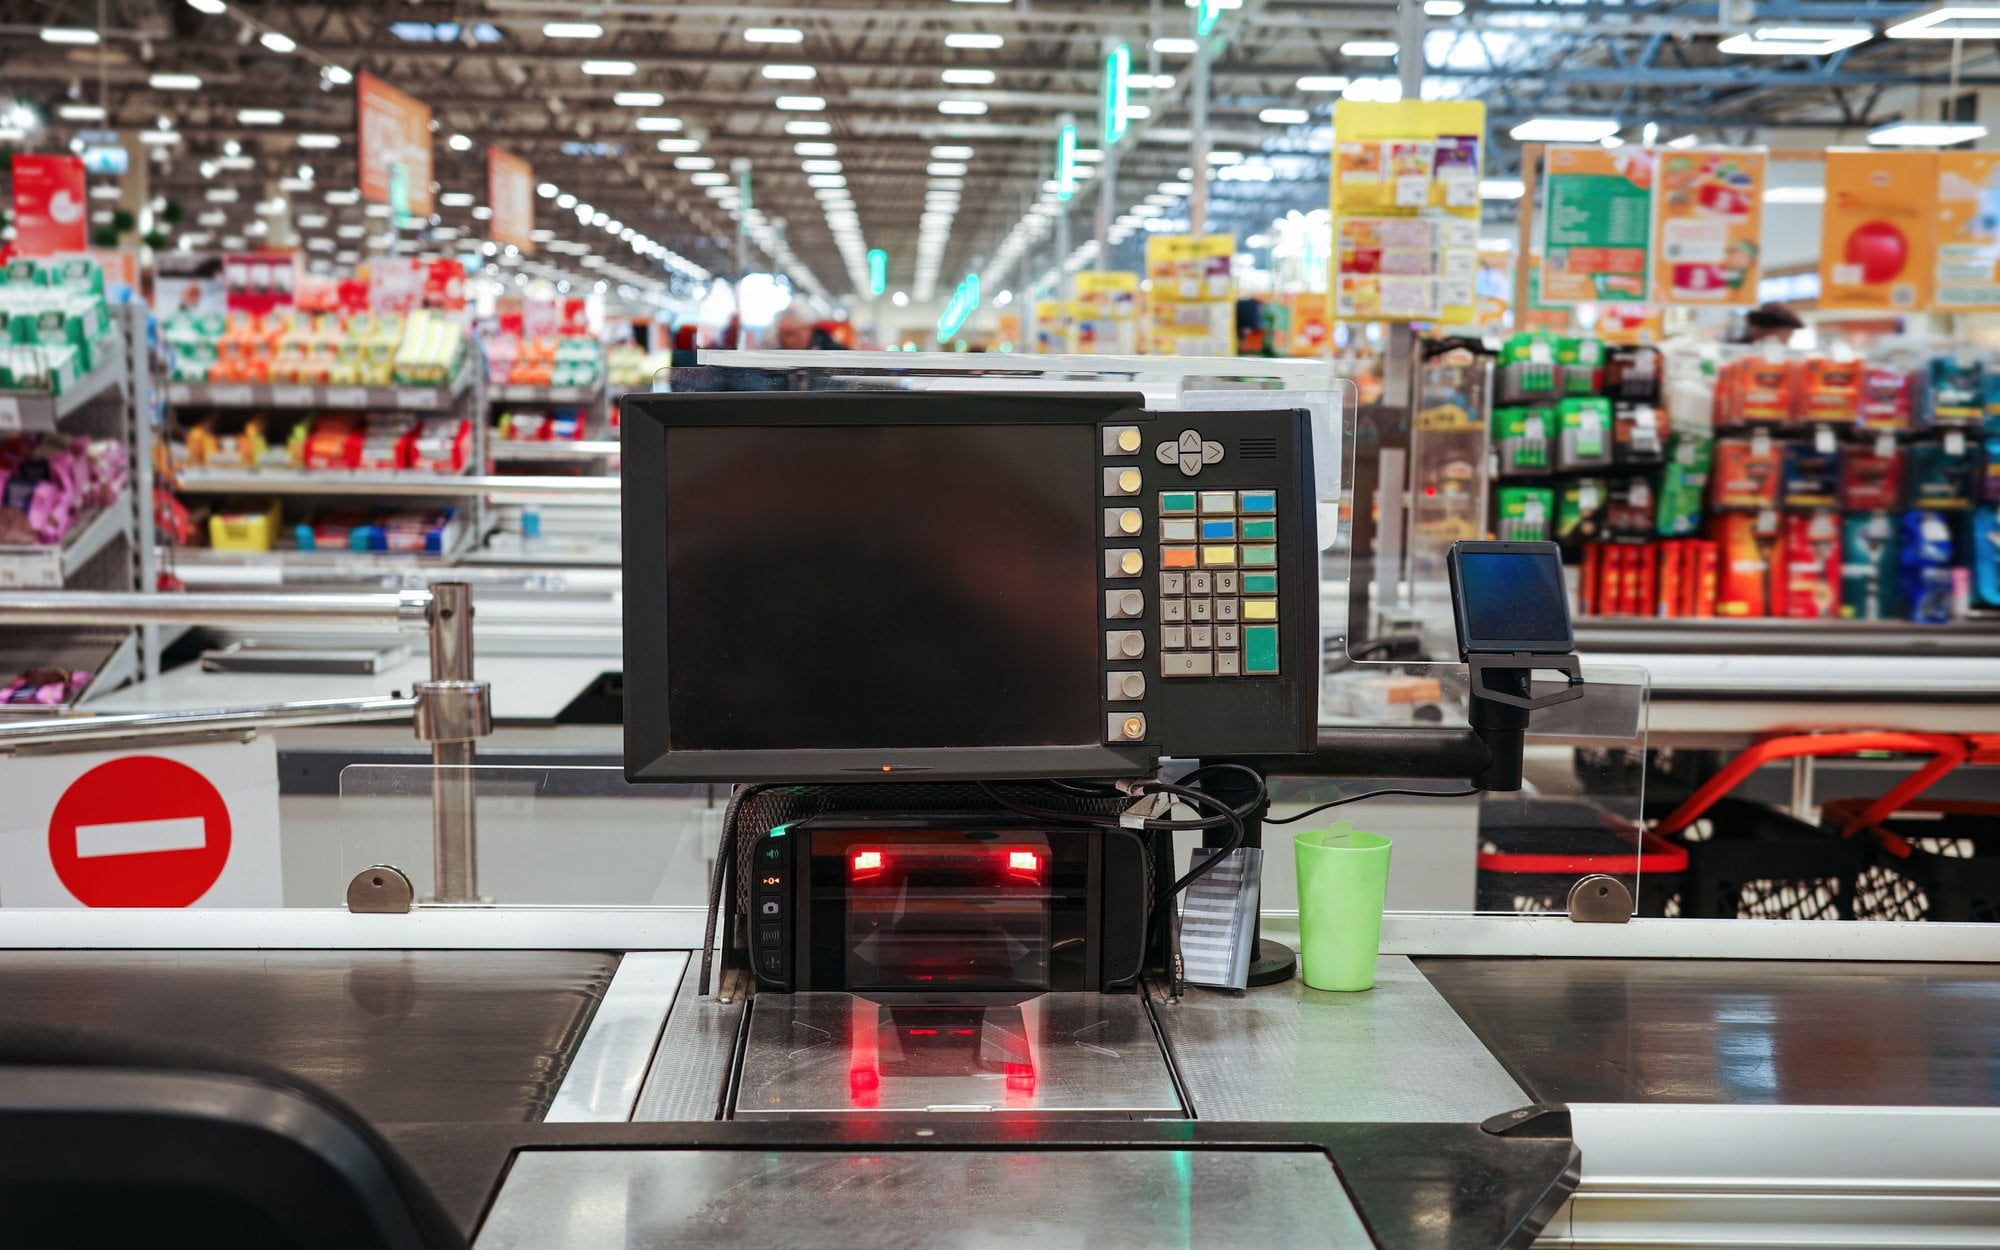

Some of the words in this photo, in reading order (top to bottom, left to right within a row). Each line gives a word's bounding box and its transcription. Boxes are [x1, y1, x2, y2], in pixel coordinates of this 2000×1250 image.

[1171, 579, 1178, 588] 7
[1197, 578, 1204, 588] 8
[1224, 578, 1231, 588] 9
[1171, 606, 1178, 615] 4
[1198, 604, 1205, 613] 5
[1224, 605, 1231, 614] 6
[1198, 632, 1205, 641] 2
[1225, 632, 1232, 641] 3
[1186, 659, 1193, 668] 0
